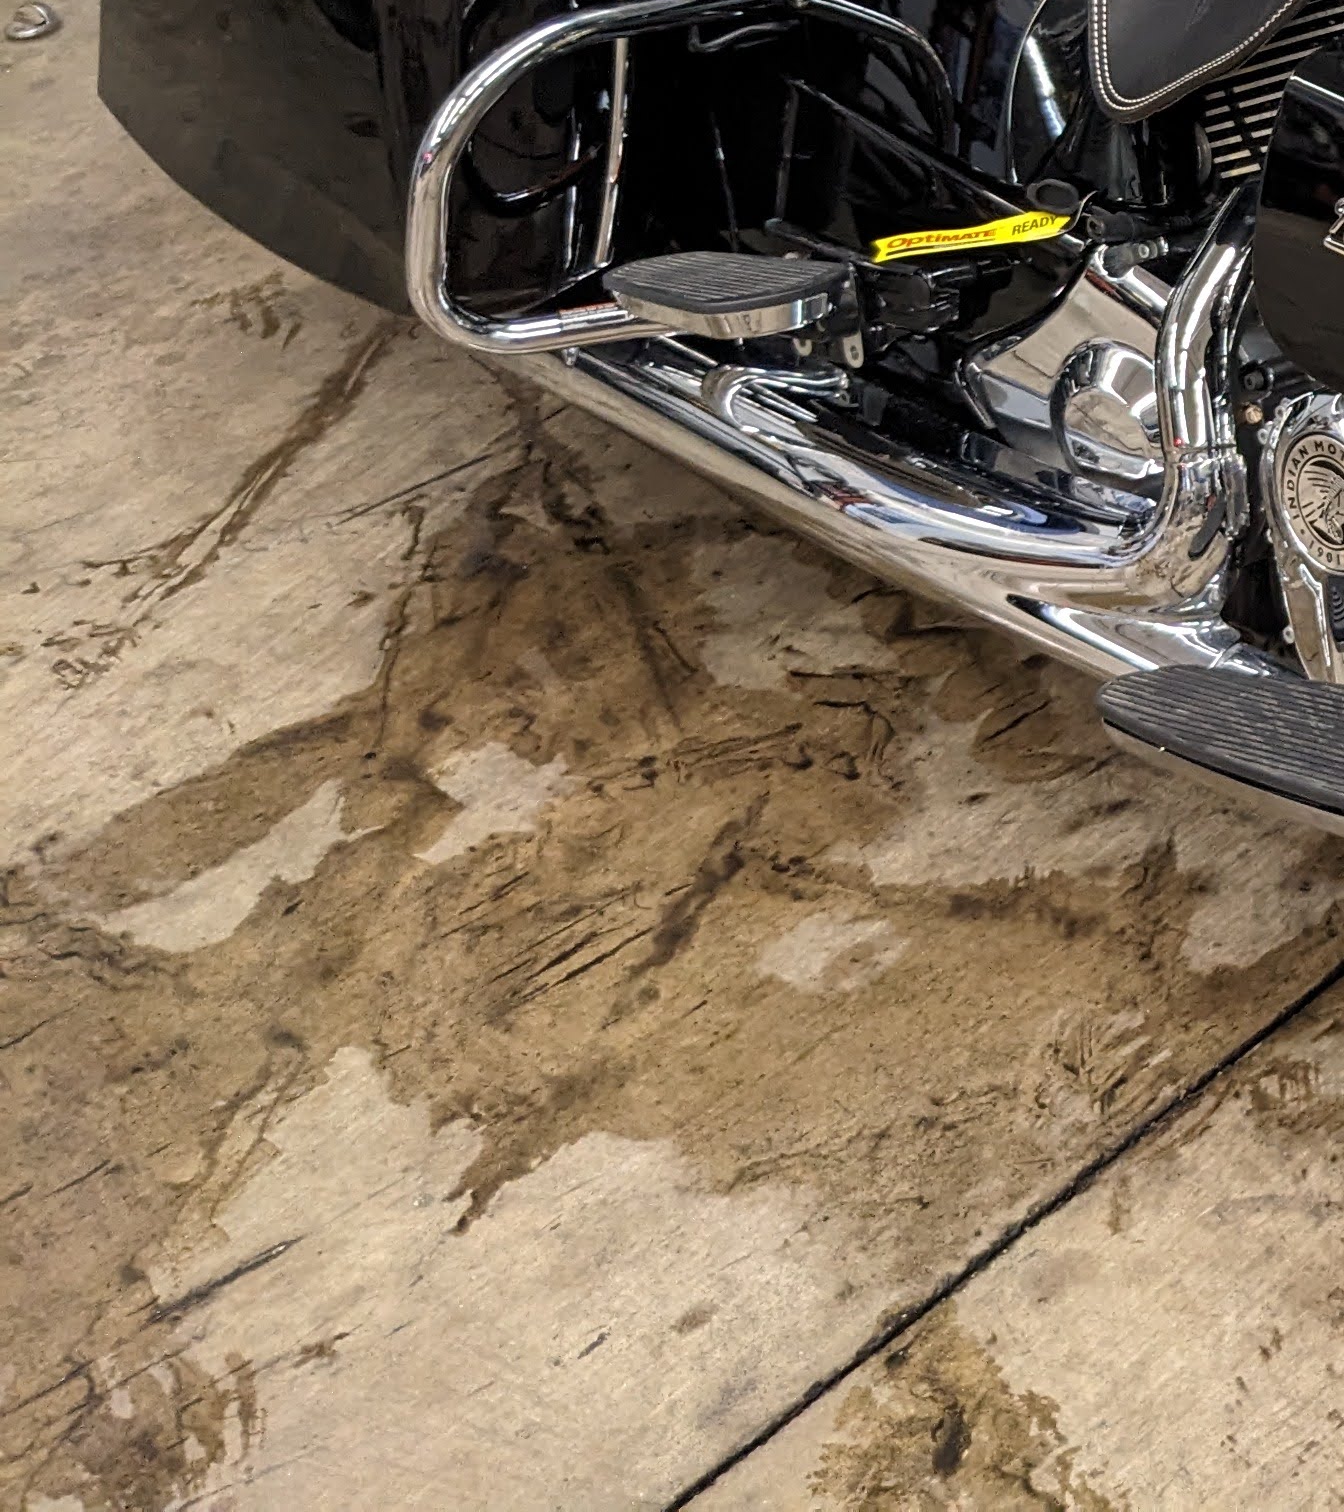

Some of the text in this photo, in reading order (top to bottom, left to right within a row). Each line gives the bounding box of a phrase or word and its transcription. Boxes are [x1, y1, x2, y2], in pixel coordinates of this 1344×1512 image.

[1011, 215, 1058, 236] READY
[1286, 445, 1309, 520] INDIAN
[1308, 540, 1341, 566] 1901
